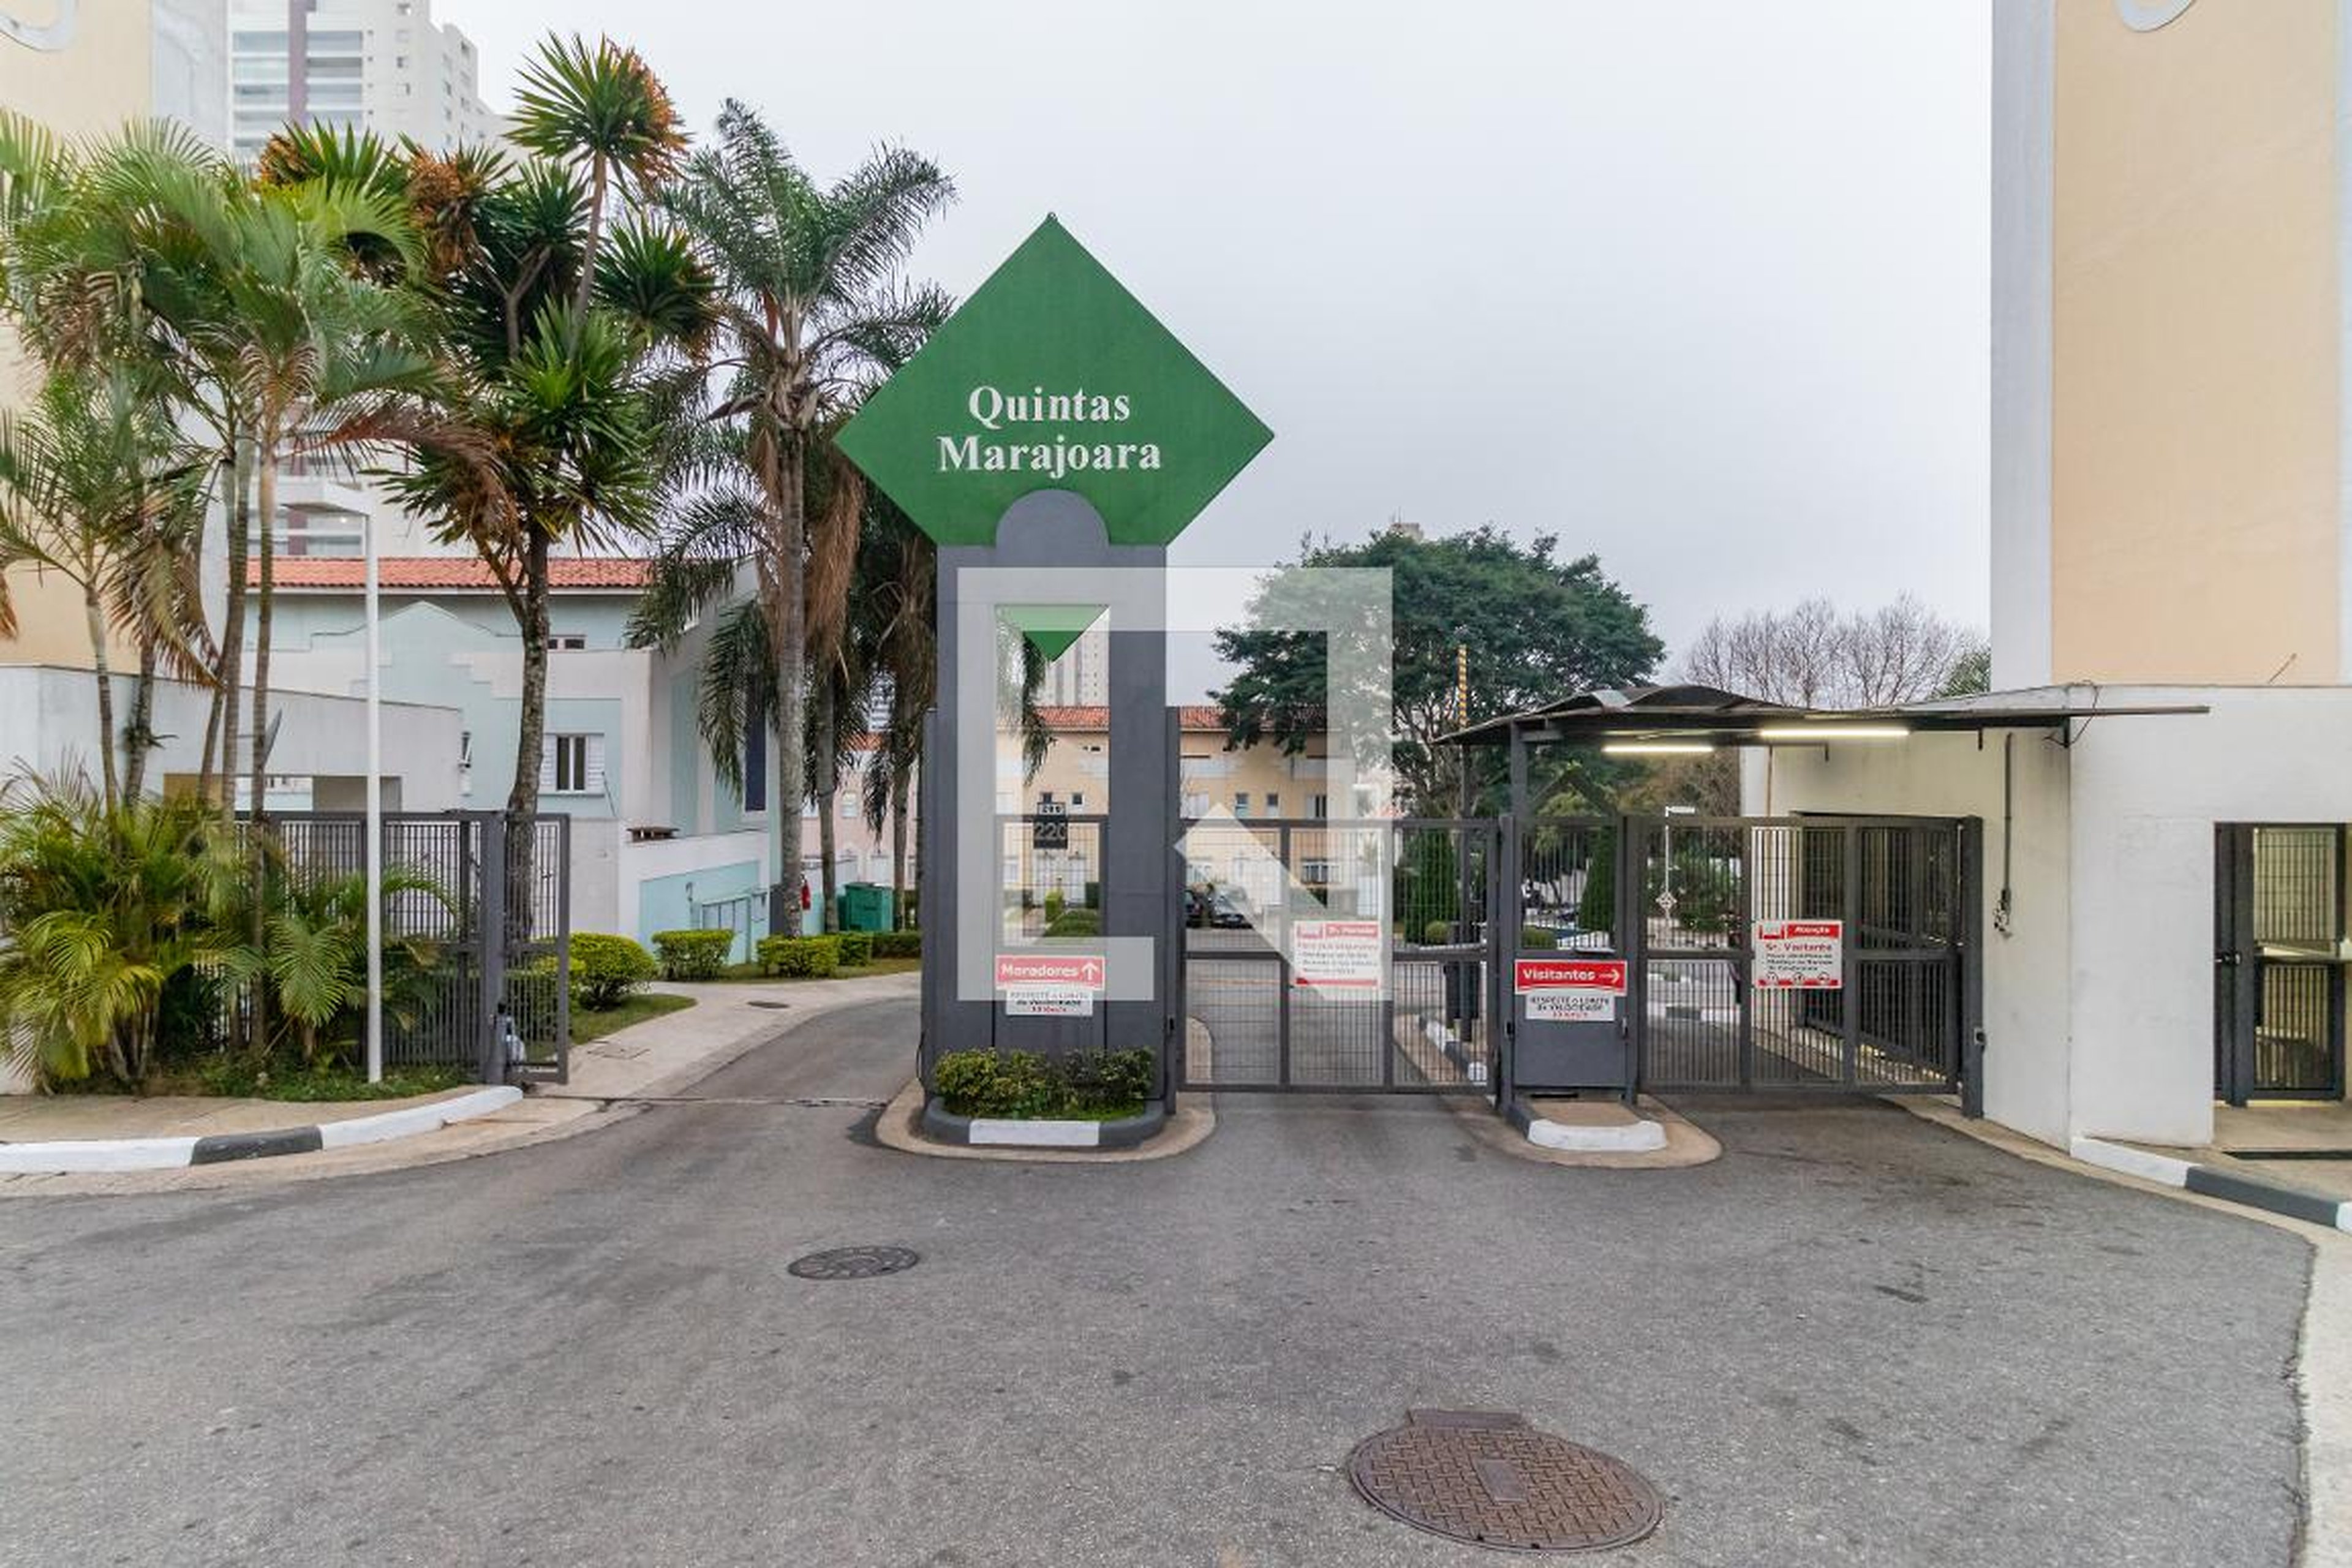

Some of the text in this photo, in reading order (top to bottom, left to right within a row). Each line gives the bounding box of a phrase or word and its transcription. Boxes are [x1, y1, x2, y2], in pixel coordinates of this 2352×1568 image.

[968, 385, 1131, 430] Quintas
[937, 434, 1162, 480] Marajoara
[1000, 962, 1079, 977] Moradores
[1522, 968, 1596, 981] Visitantes
